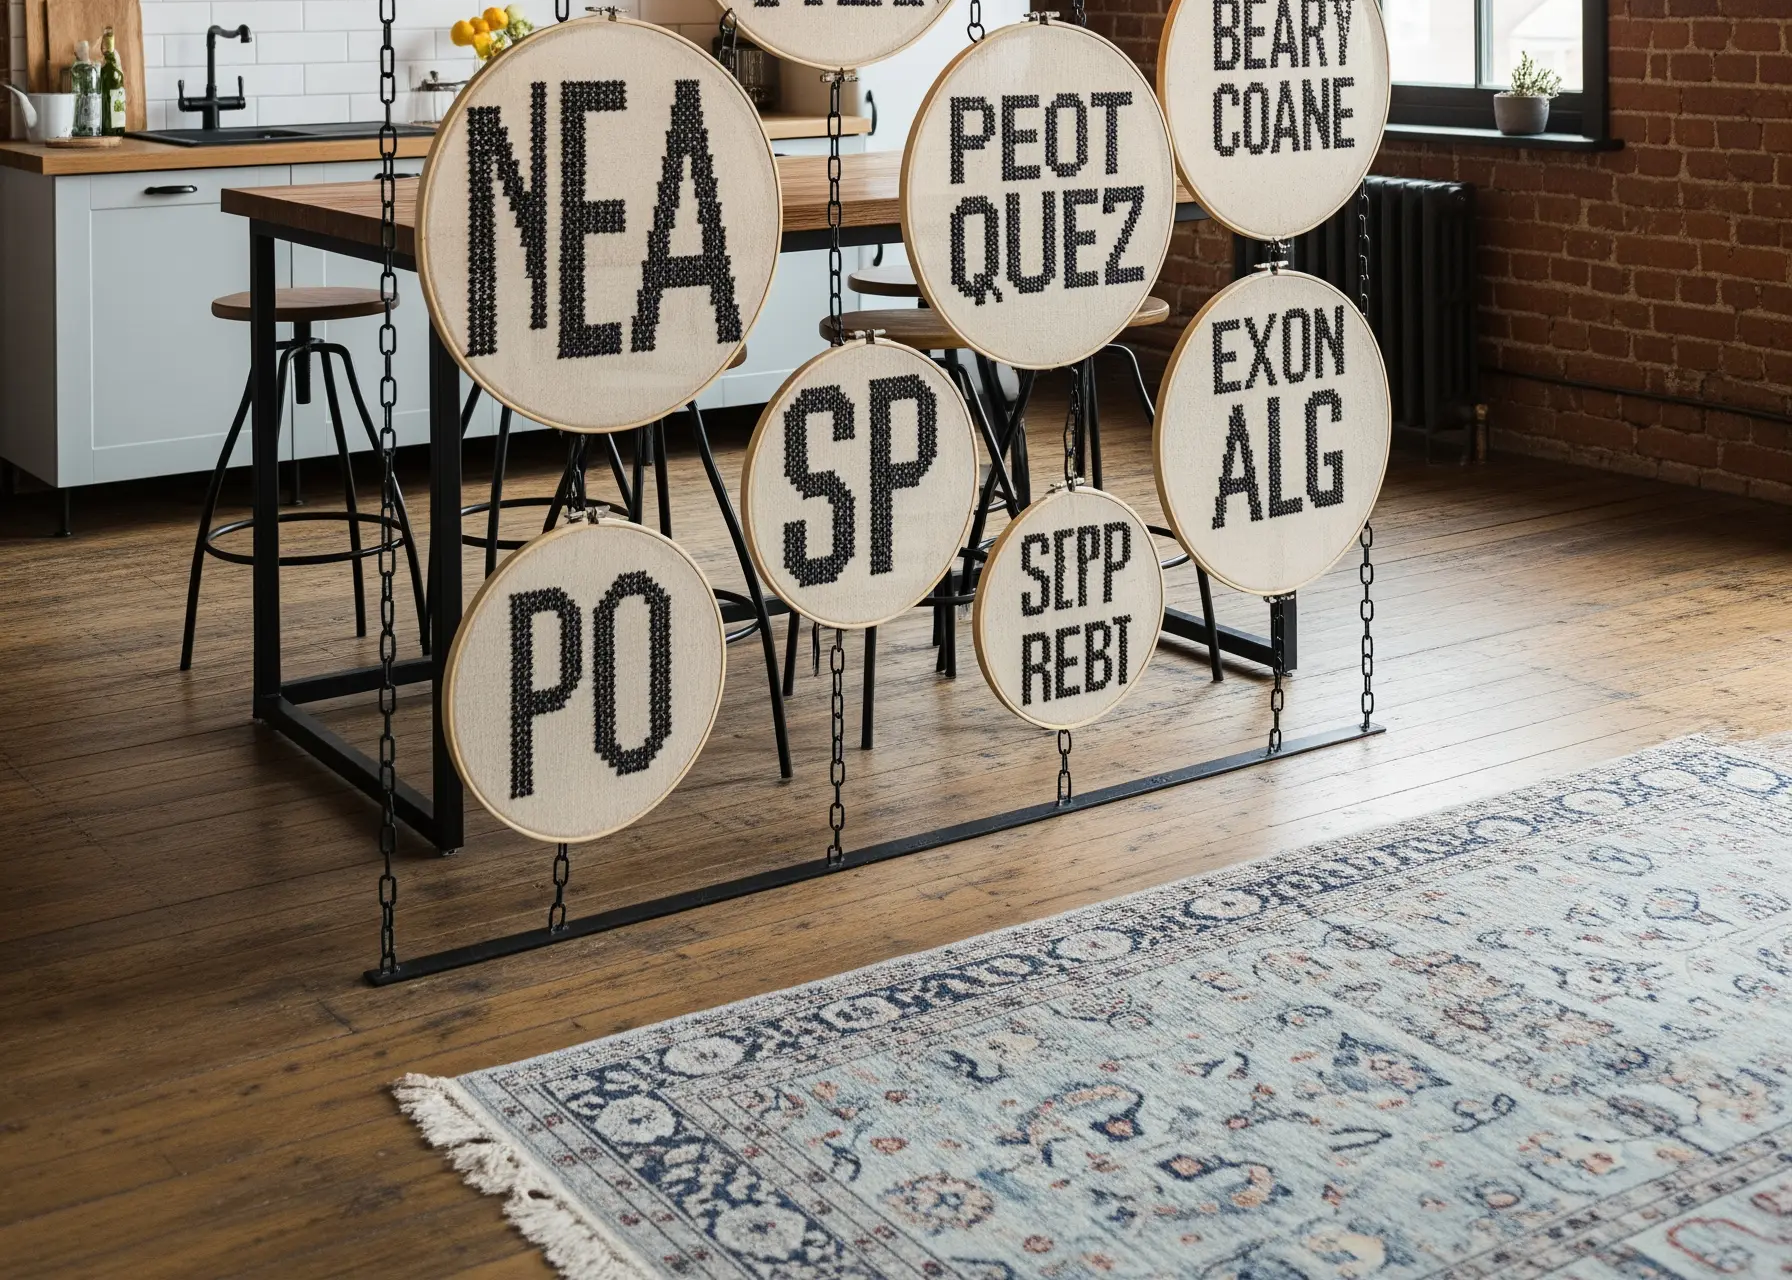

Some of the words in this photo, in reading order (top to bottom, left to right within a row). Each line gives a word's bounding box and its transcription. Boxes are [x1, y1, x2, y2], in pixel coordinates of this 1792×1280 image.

[949, 91, 1133, 185] PEOT
[1212, 76, 1355, 158] COANE
[464, 79, 744, 360] NEA
[949, 185, 1145, 307] QUEZ
[1211, 304, 1345, 395] EXON
[783, 374, 938, 589] SP
[1211, 388, 1345, 531] ALG
[508, 570, 673, 801] PO
[1021, 613, 1133, 707] REBT
